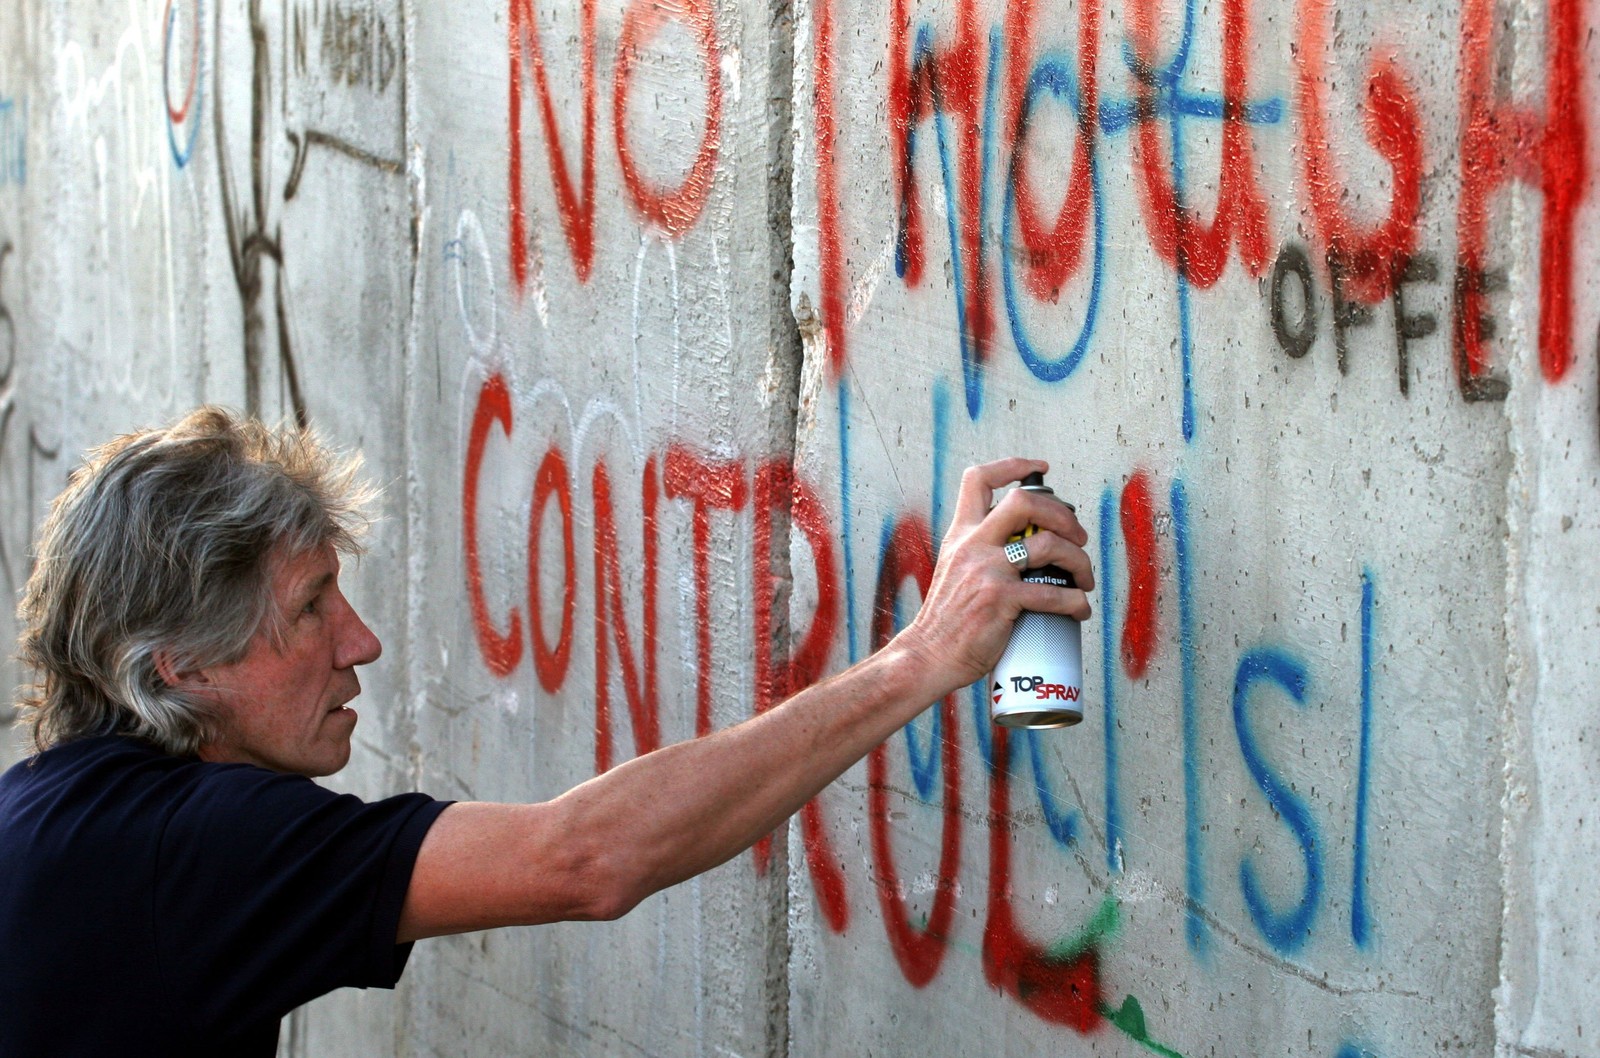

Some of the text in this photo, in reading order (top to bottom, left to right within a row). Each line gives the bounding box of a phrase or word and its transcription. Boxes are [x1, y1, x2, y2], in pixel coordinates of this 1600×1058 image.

[1024, 576, 1067, 585] acrylique
[1011, 676, 1080, 702] TOP SPRAY
